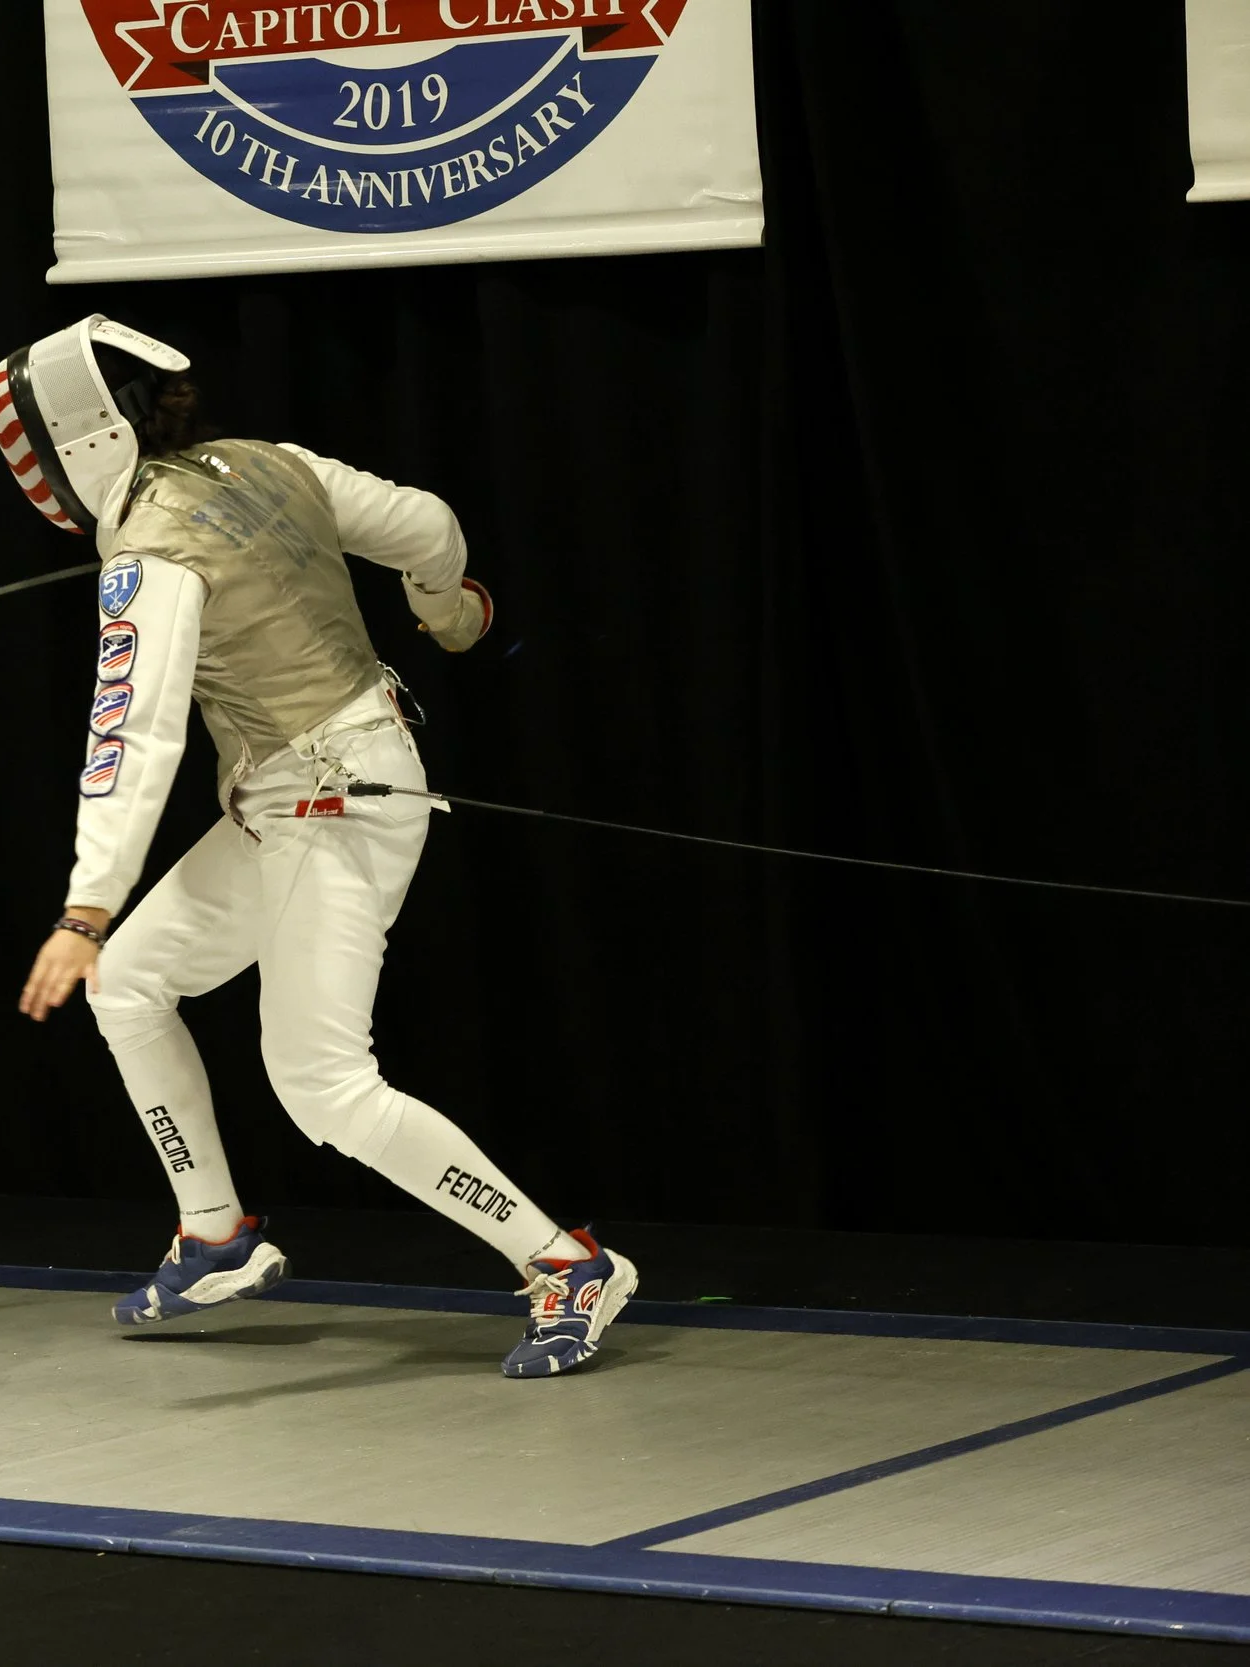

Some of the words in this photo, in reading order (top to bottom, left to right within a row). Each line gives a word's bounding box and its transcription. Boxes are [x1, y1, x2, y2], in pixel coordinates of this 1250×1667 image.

[170, 0, 400, 54] CAPITOL
[332, 73, 450, 131] 2019
[300, 71, 596, 209] ANNIVERSARY
[102, 567, 137, 595] 5T
[145, 1105, 195, 1174] FENCING
[435, 1164, 518, 1223] FENCING
